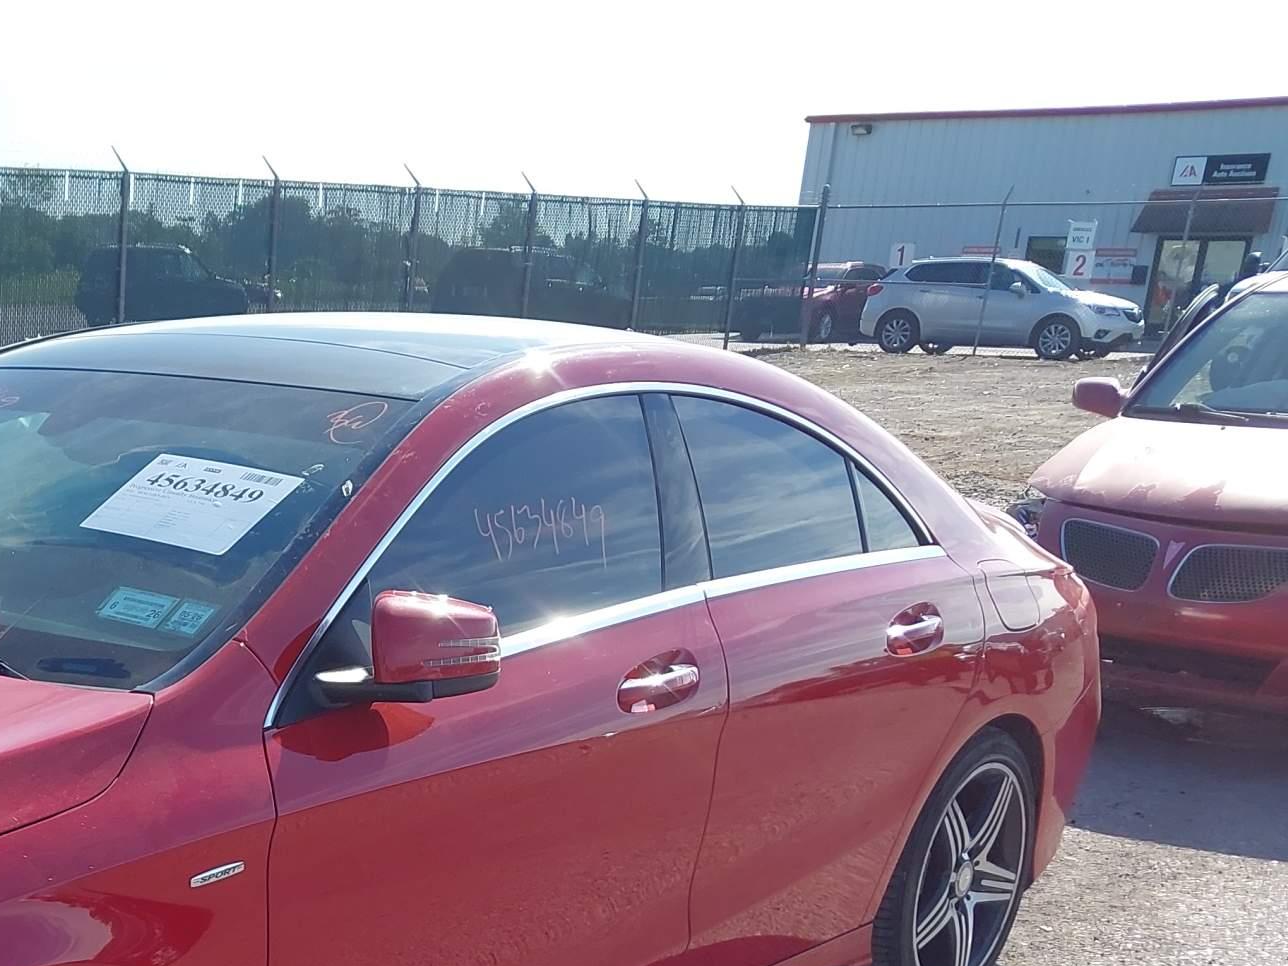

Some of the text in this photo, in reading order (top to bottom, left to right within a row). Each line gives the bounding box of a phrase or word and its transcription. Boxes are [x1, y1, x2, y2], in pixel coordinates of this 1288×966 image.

[897, 245, 905, 266] 1
[1073, 255, 1087, 276] 2
[145, 472, 265, 504] 45634849
[474, 497, 607, 568] 45634849
[200, 865, 239, 883] SPORT
